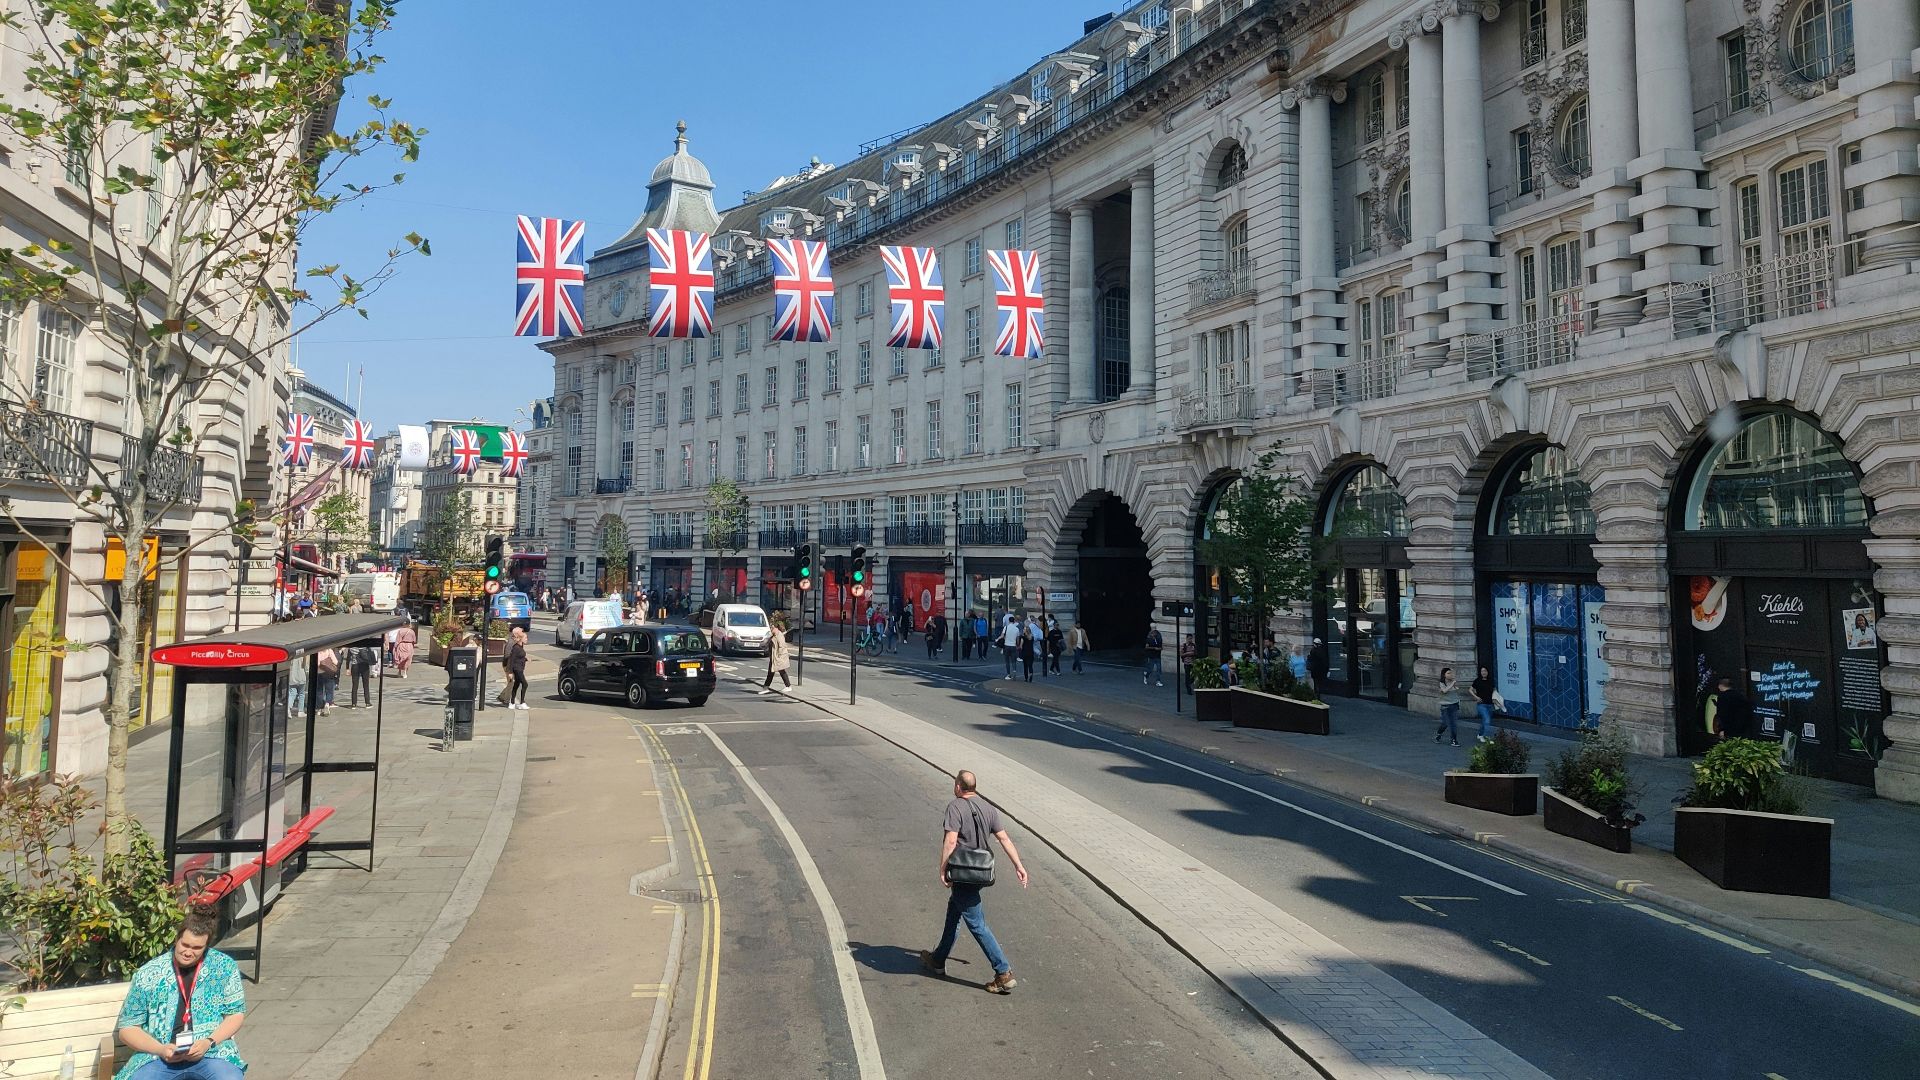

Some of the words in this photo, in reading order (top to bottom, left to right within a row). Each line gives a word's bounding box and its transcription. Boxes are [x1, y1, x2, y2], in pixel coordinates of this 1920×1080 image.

[1758, 594, 1804, 612] Kiehl's
[1500, 608, 1521, 619] SHOP
[1591, 613, 1602, 624] SH
[1506, 624, 1517, 634] TO
[1506, 640, 1518, 650] LET
[226, 650, 250, 658] Circus
[1509, 662, 1517, 672] 69
